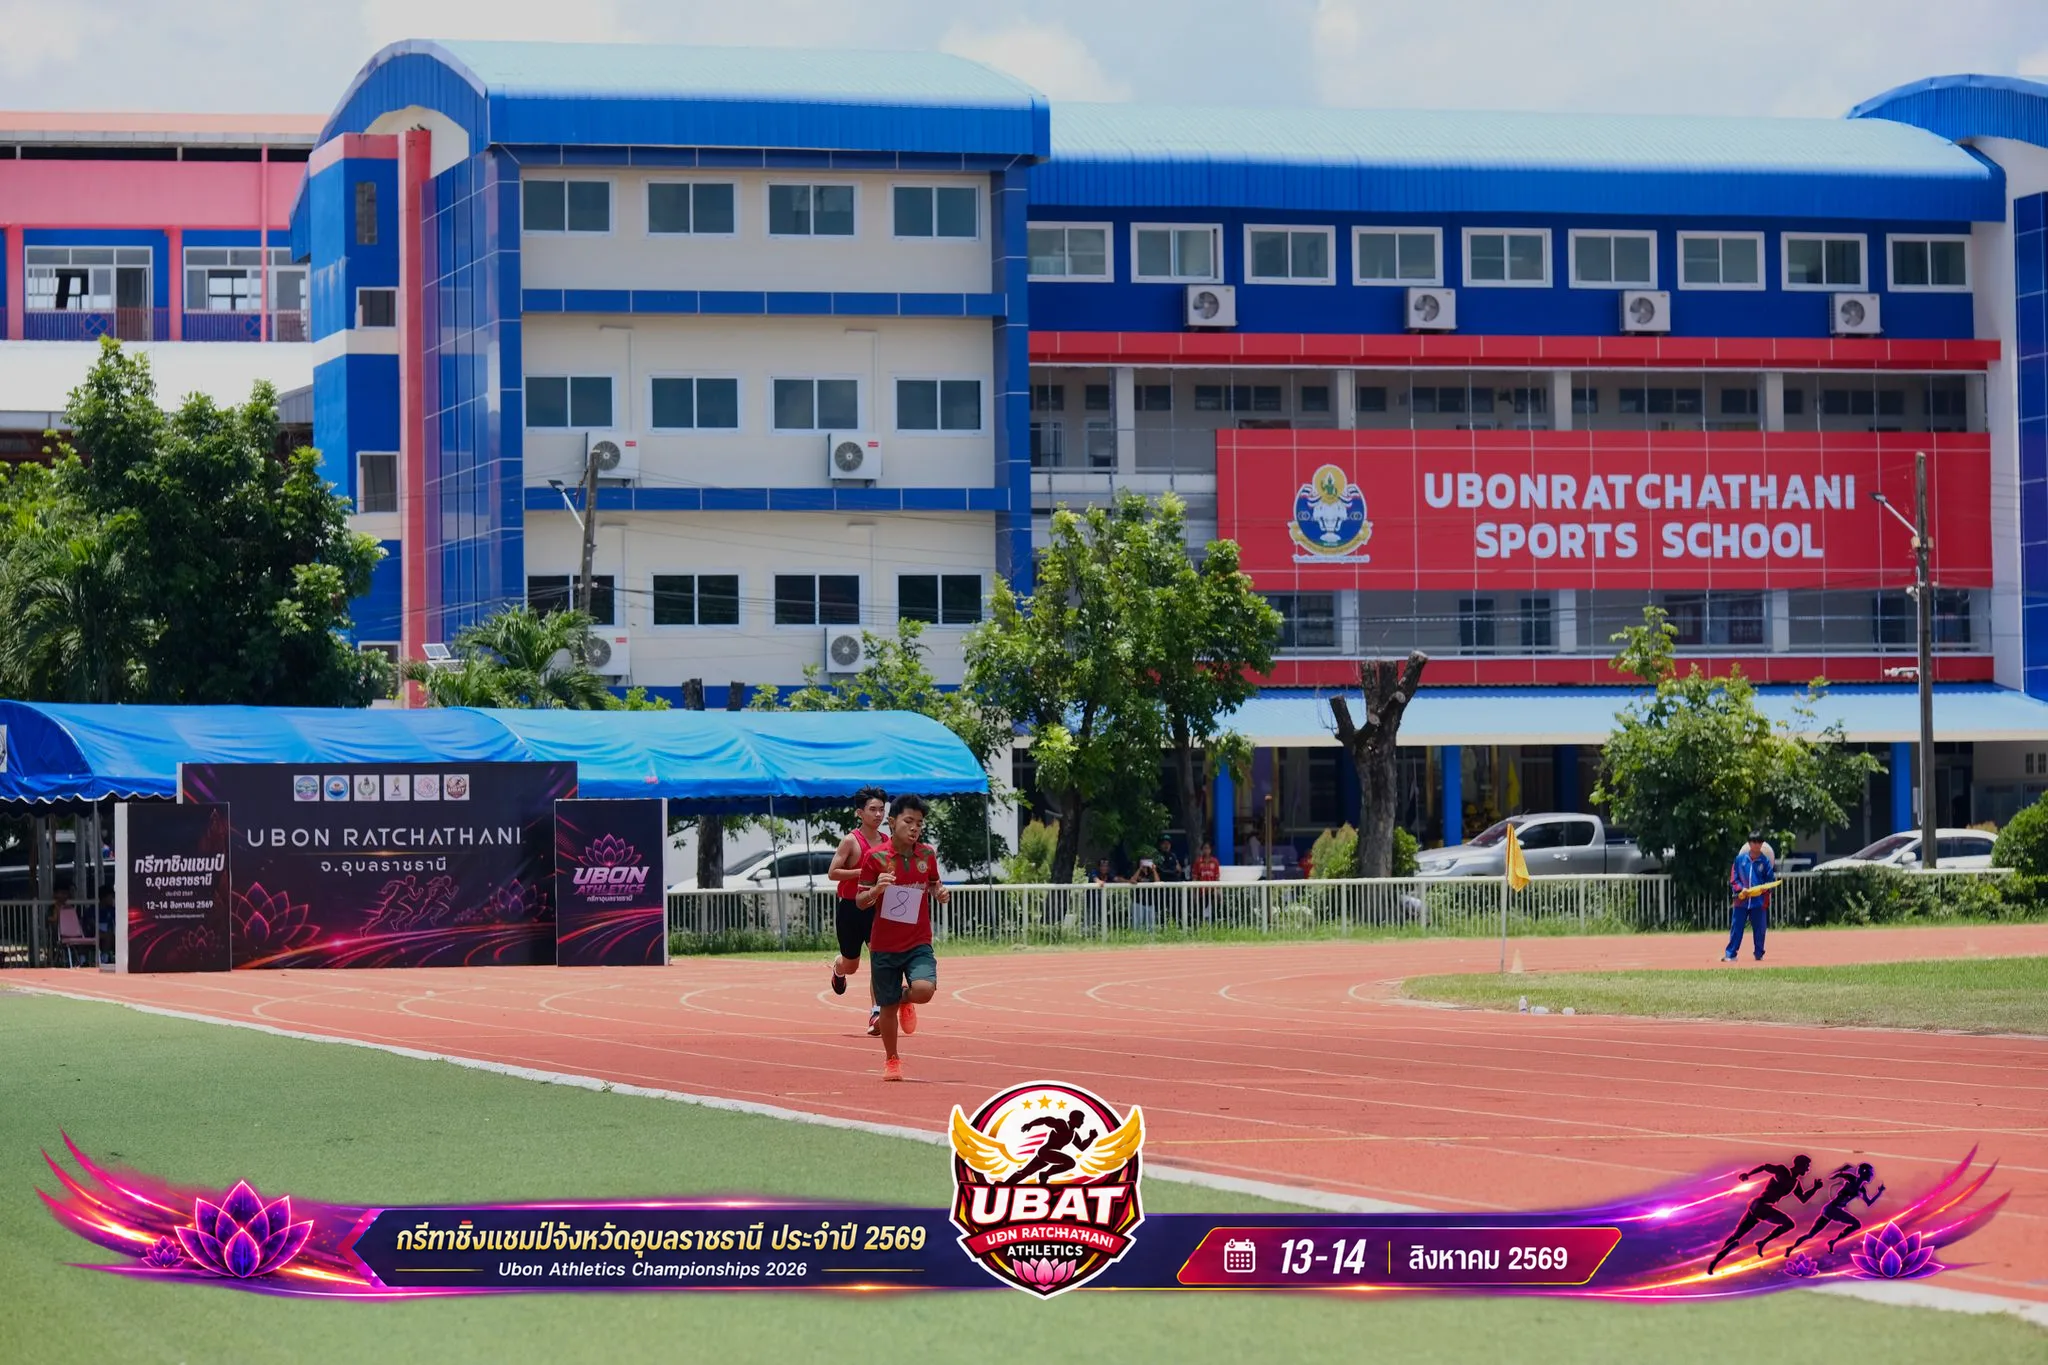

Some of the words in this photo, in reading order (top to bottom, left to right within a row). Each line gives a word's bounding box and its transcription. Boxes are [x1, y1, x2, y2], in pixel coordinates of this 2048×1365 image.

[1424, 473, 1856, 511] UBONRATCHATHANI
[1475, 522, 1638, 559] SPORTS
[1662, 522, 1824, 558] SCHOOL
[247, 828, 330, 847] UBON
[343, 827, 522, 846] RATCHATHANI
[320, 856, 447, 877] จ.อุบลราชธานี
[572, 866, 650, 884] UBON
[574, 884, 646, 895] ATHLETICS
[146, 900, 168, 910] 12-14
[196, 900, 214, 908] 2569
[889, 890, 910, 917] 8
